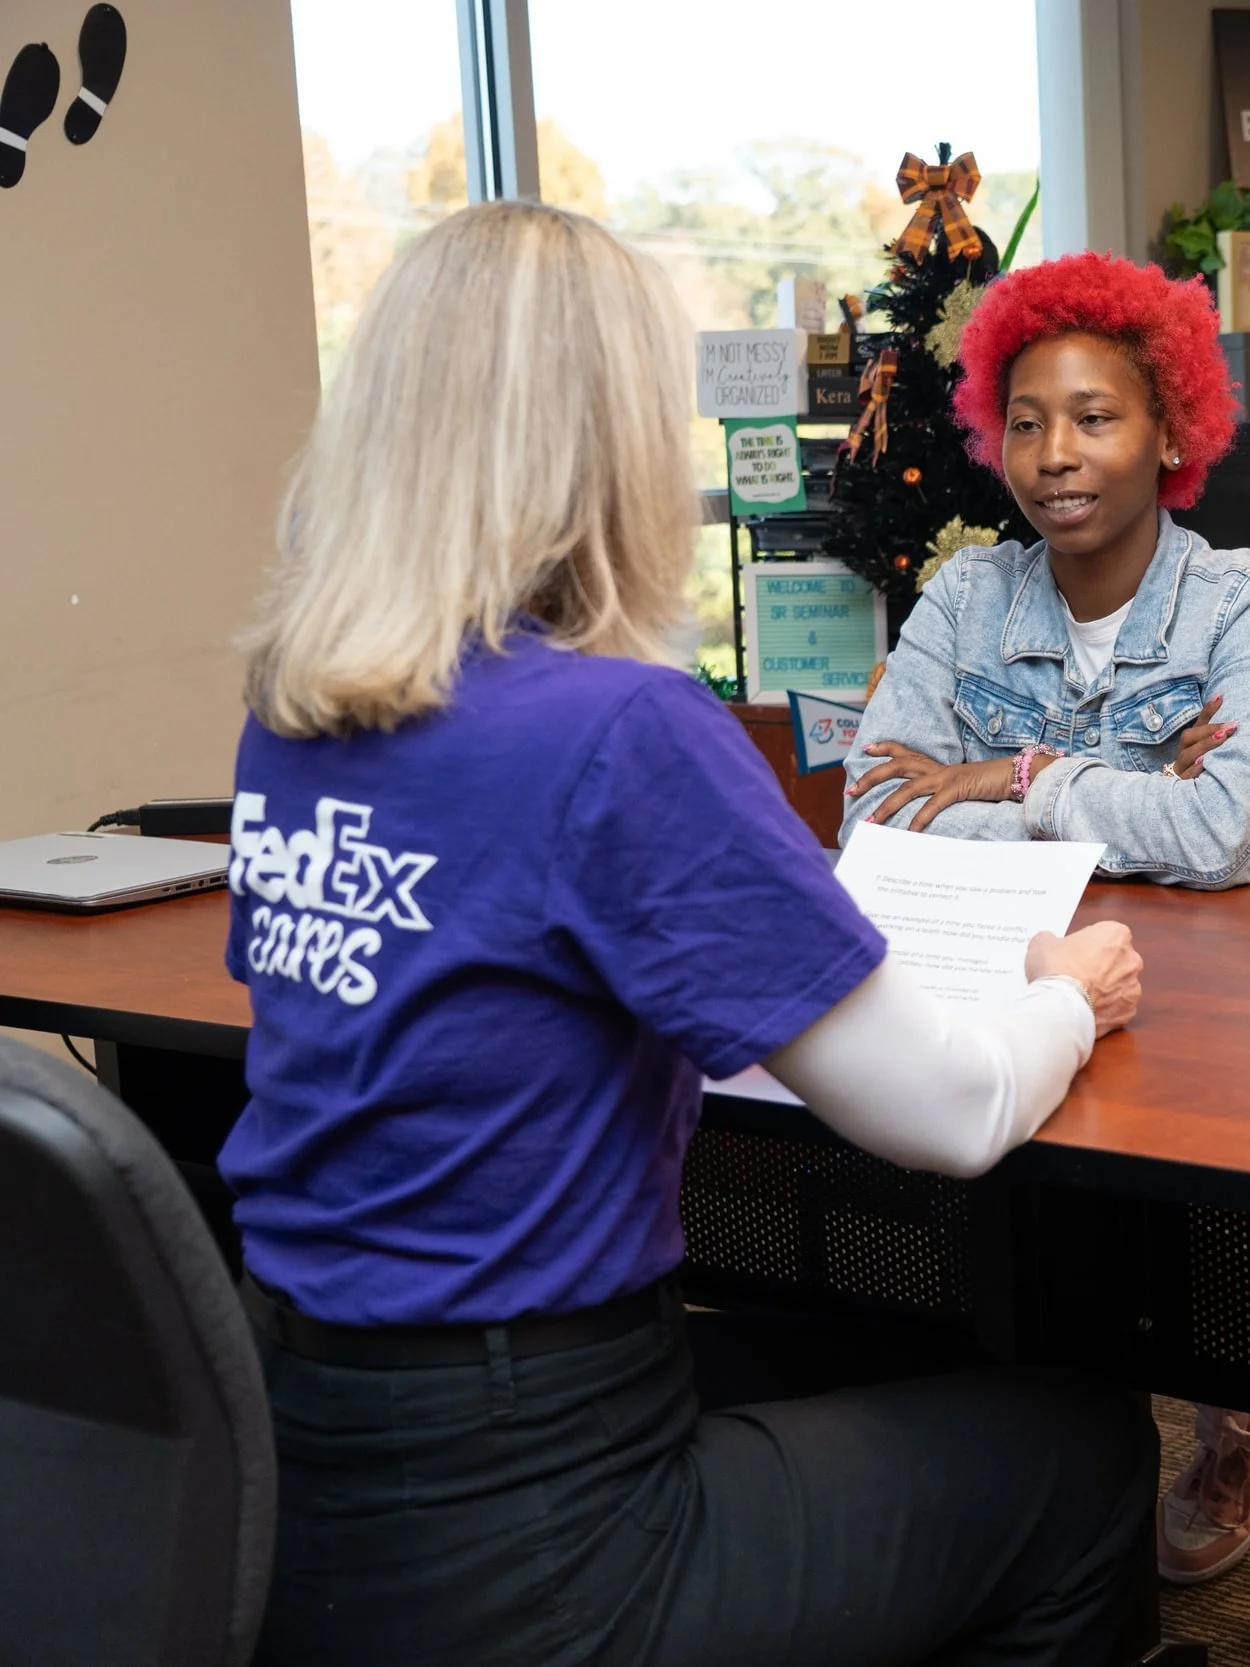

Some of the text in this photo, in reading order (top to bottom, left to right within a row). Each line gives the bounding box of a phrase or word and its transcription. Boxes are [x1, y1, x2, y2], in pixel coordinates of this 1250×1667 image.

[719, 343, 741, 364] NOT
[746, 341, 789, 363] MESSY
[715, 385, 780, 407] ORGANIZED
[815, 387, 852, 405] Kera
[741, 437, 754, 447] THE
[776, 435, 784, 446] IS
[767, 448, 791, 459] RIGHT
[752, 462, 763, 472] TO
[761, 474, 768, 485] IS
[767, 579, 855, 594] WELCOME TO
[770, 605, 850, 620] SR SEMINAR
[763, 656, 830, 671] CUSTOMER
[248, 906, 381, 1004] cares
